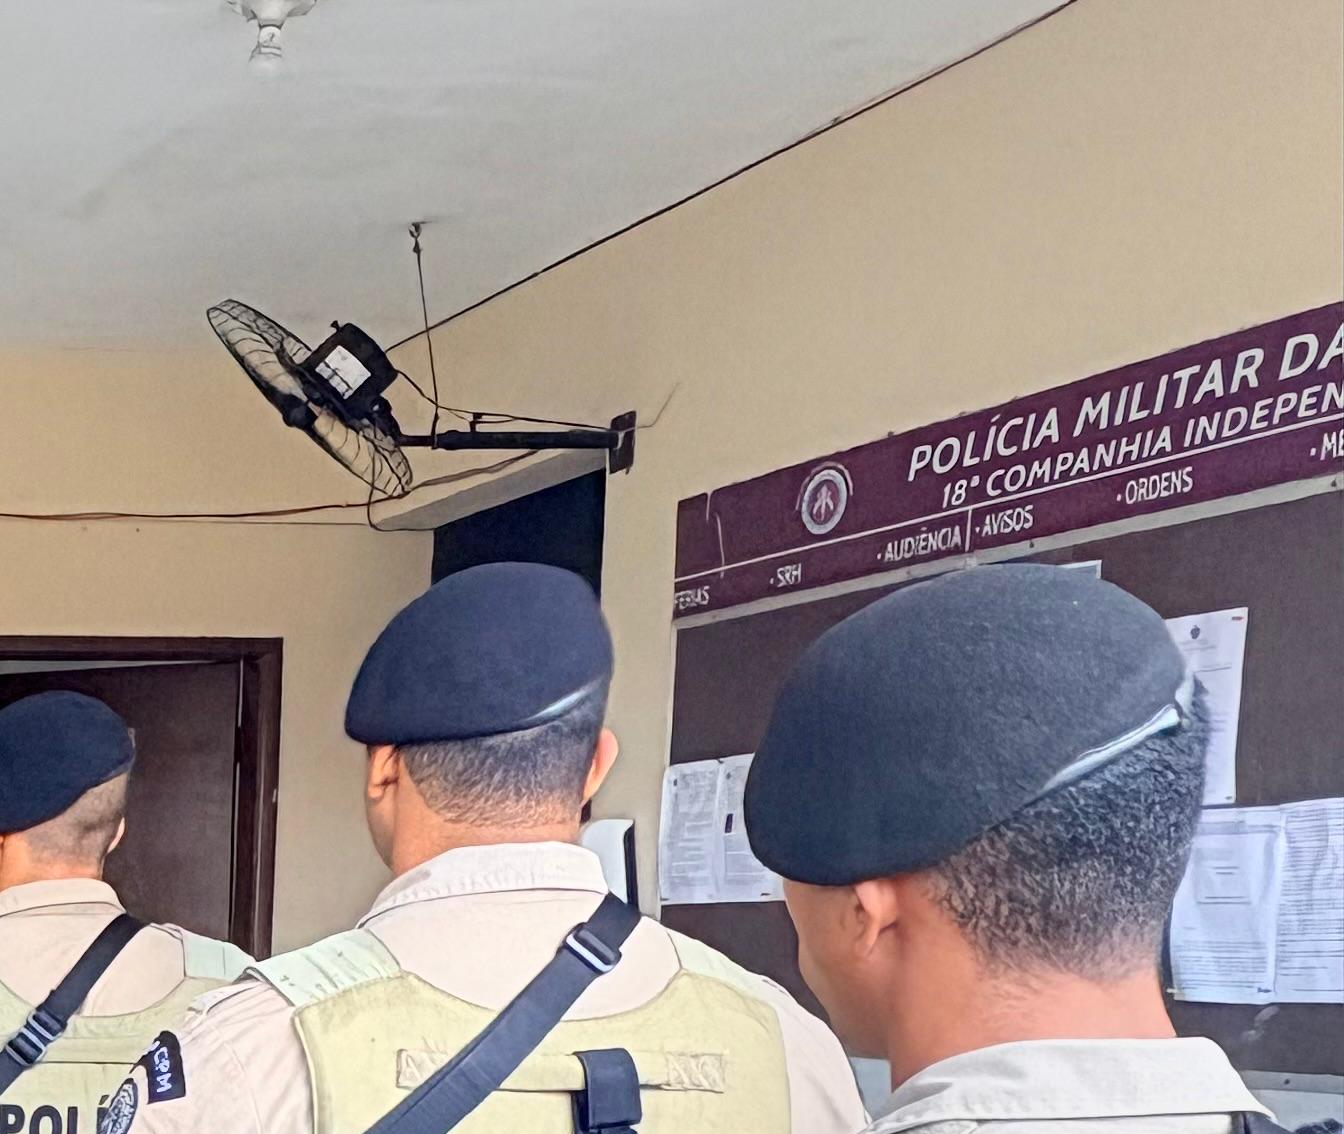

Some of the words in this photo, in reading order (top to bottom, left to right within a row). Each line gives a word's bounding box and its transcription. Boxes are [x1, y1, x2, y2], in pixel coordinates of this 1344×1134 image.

[908, 407, 1060, 482] POLÍCIA
[1073, 347, 1265, 437] MILITAR
[1278, 322, 1344, 381] DA
[986, 425, 1173, 497] COMPANHIA
[1126, 466, 1194, 505] ORDENS
[981, 505, 1034, 537] AVISOS
[884, 526, 962, 562] AUDIÊNCIA
